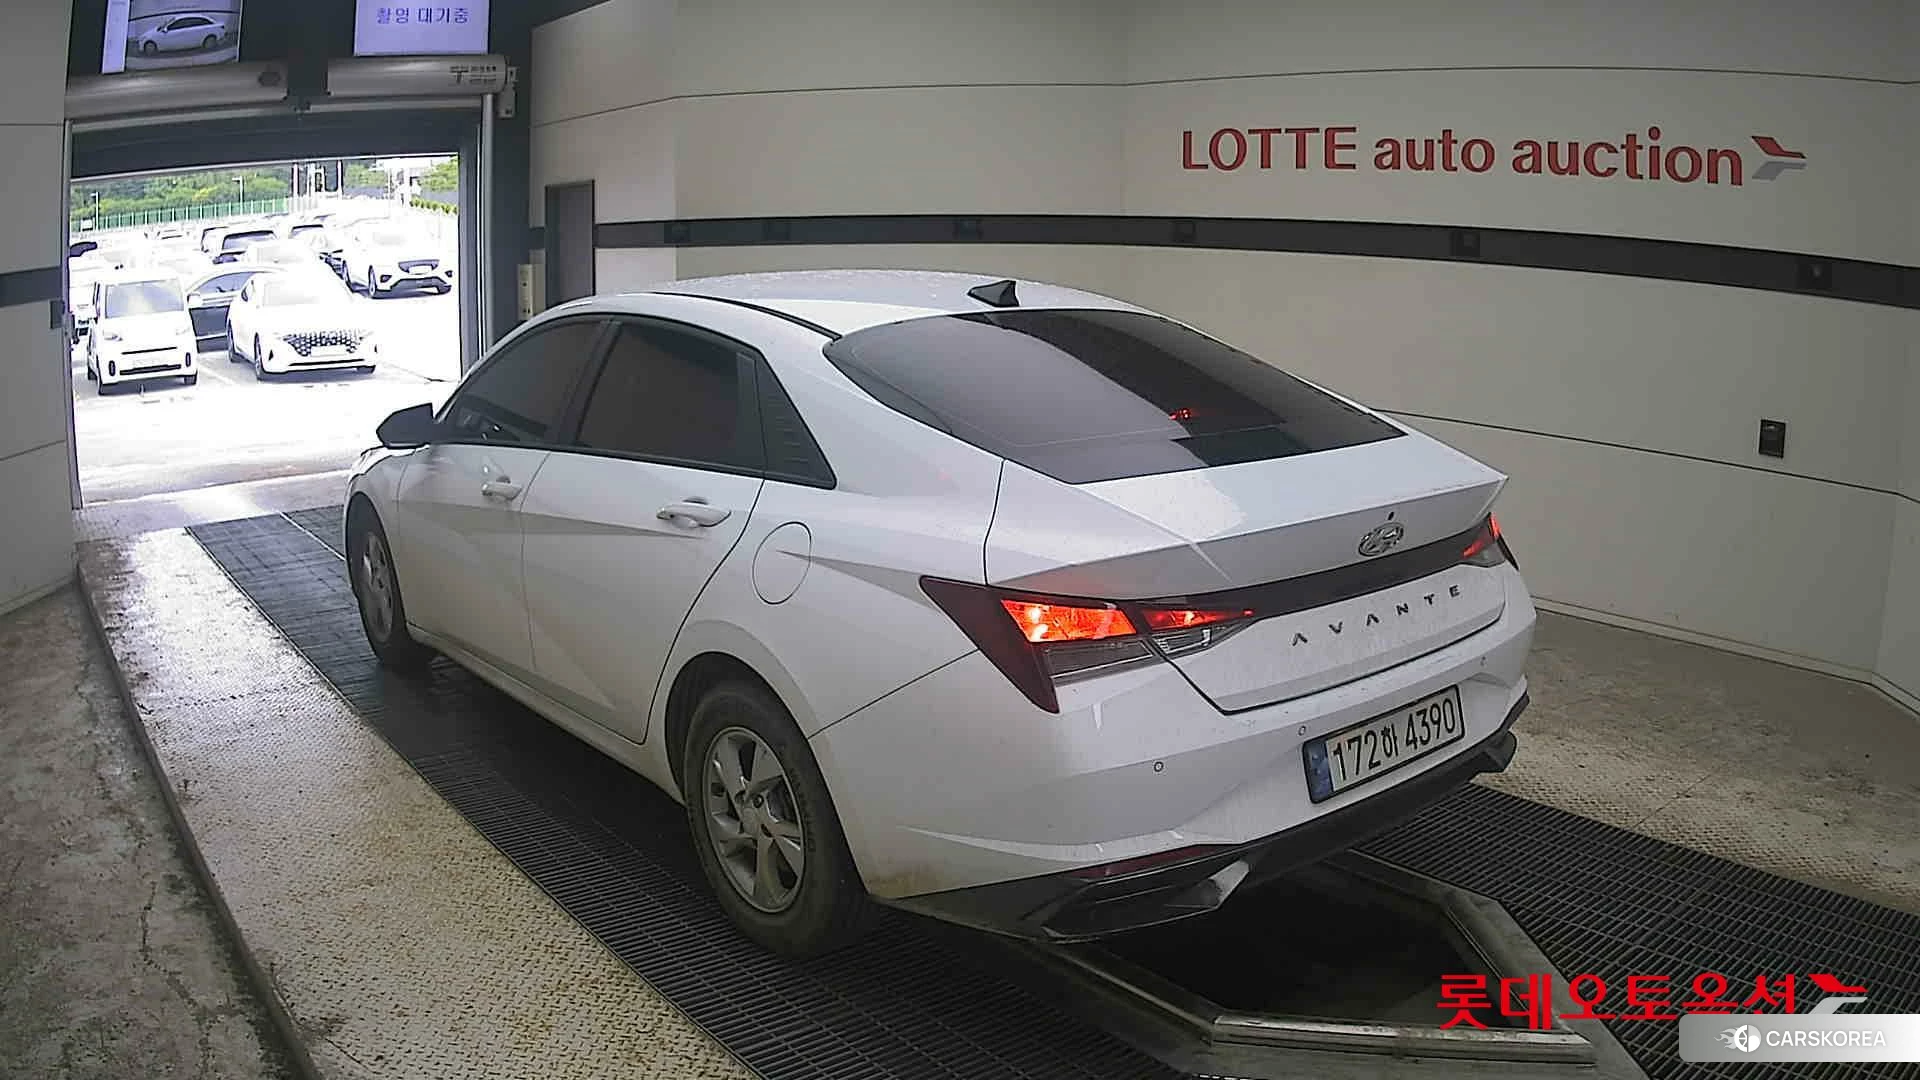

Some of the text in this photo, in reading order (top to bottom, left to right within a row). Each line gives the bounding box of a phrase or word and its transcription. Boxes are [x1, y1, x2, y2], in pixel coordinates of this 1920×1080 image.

[418, 7, 469, 24] 대기중
[1182, 126, 1743, 186] LOTTE auto auction
[1291, 585, 1461, 647] AVANTE
[1405, 698, 1456, 750] 4390
